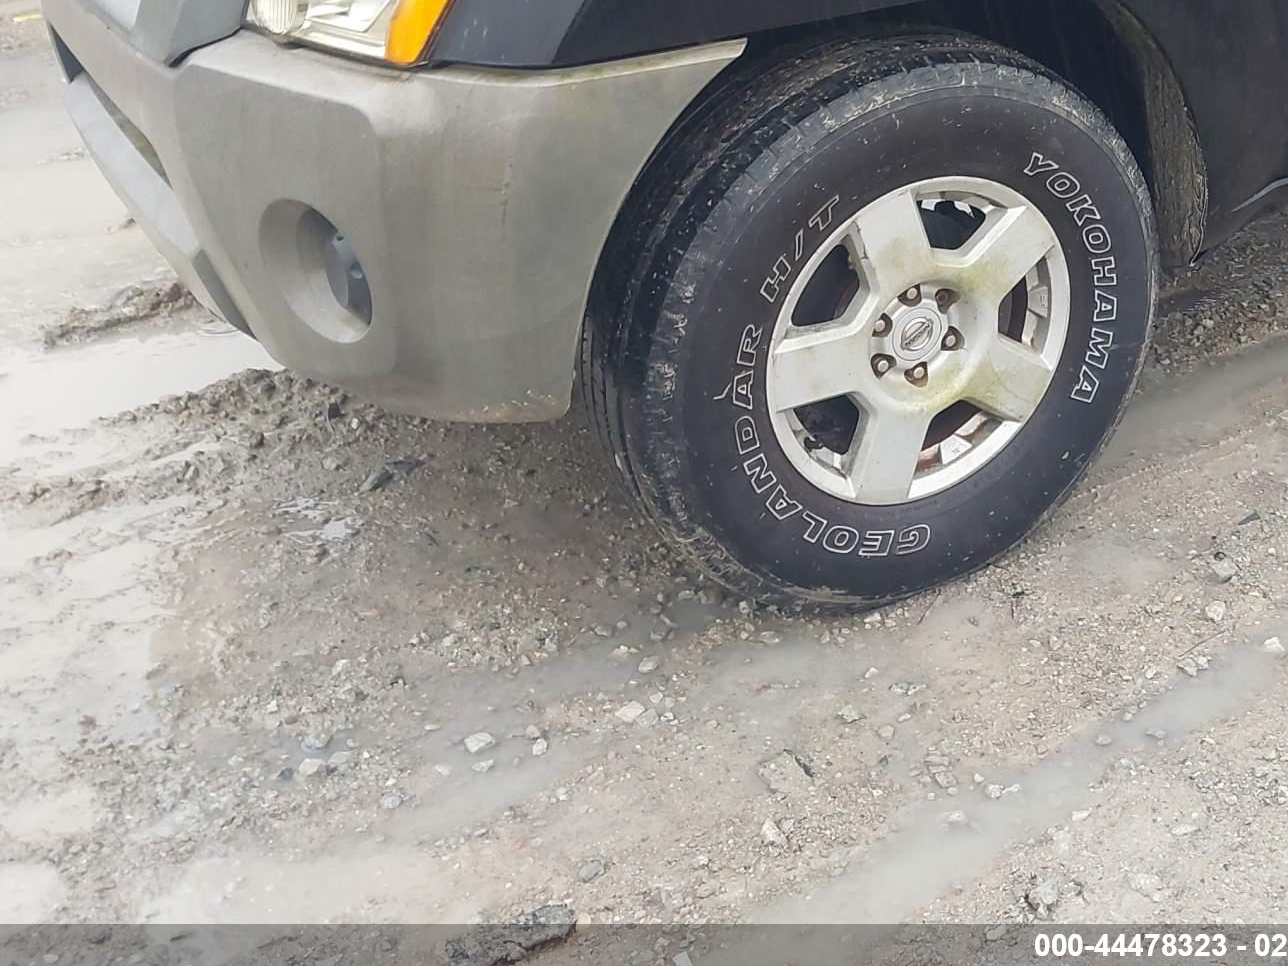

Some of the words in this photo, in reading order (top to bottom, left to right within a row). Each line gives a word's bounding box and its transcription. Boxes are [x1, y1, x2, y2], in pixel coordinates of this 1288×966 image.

[760, 194, 840, 304] H/T
[1024, 152, 1118, 403] YOKOHAMA
[733, 323, 931, 557] GEOLANDAR
